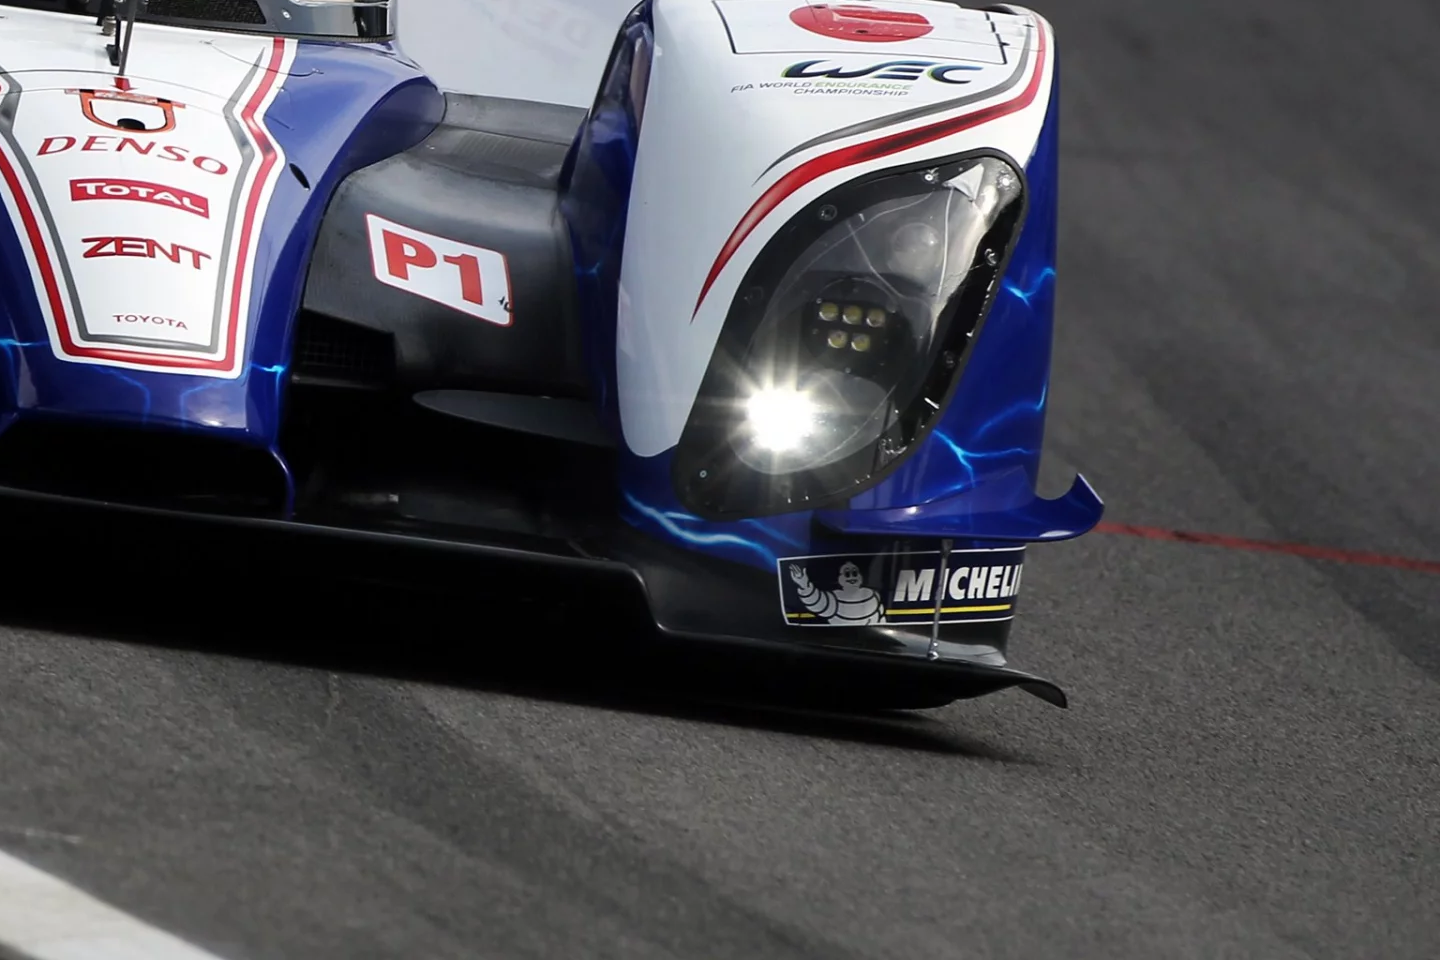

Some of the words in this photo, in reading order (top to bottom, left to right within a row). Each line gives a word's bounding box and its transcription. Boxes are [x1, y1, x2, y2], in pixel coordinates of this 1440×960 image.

[780, 59, 984, 85] WEC
[731, 84, 755, 93] FIA
[759, 81, 811, 90] WORLD
[815, 81, 915, 91] ENDURANCE
[793, 88, 909, 97] CHAMPIONSHIP
[36, 135, 229, 175] DENSO
[76, 182, 206, 213] TOTAL
[81, 236, 212, 270] ZENT
[382, 229, 483, 306] P1
[112, 313, 189, 330] TOYOTA
